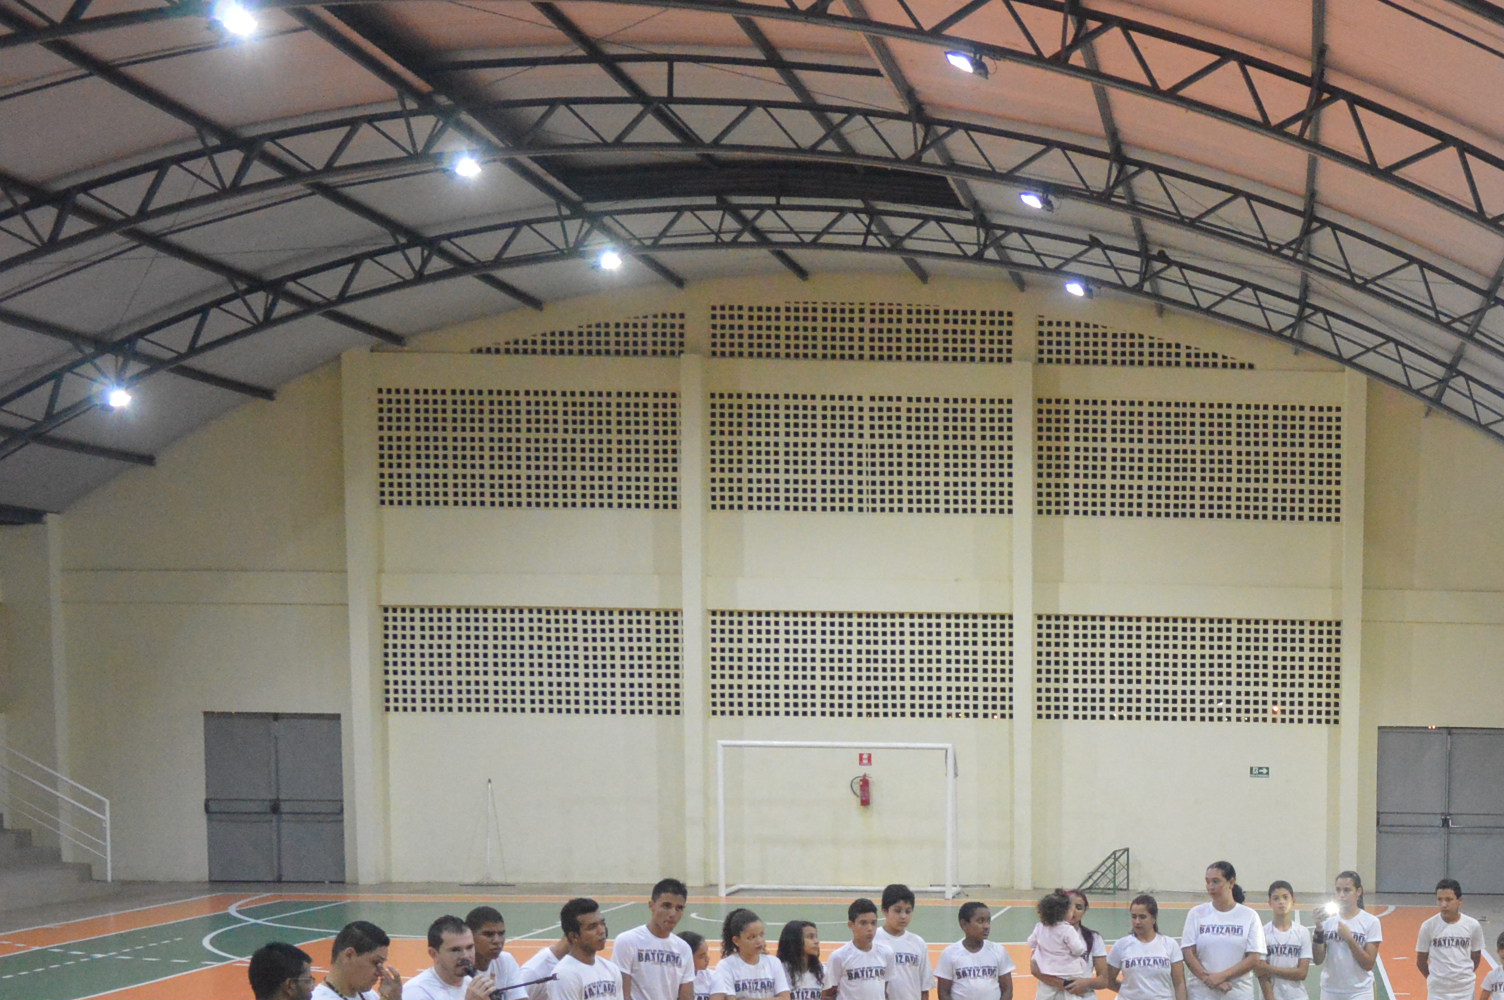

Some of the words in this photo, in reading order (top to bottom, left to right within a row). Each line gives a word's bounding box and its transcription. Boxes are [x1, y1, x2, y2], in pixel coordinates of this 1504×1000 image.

[1199, 925, 1244, 937] BATIZADO
[1432, 937, 1471, 949] BATIZADO
[637, 951, 683, 968] BATIZADO
[1124, 958, 1170, 969] BATIZADO
[846, 967, 886, 981] BATIZAD
[955, 967, 998, 980] BATIZADO
